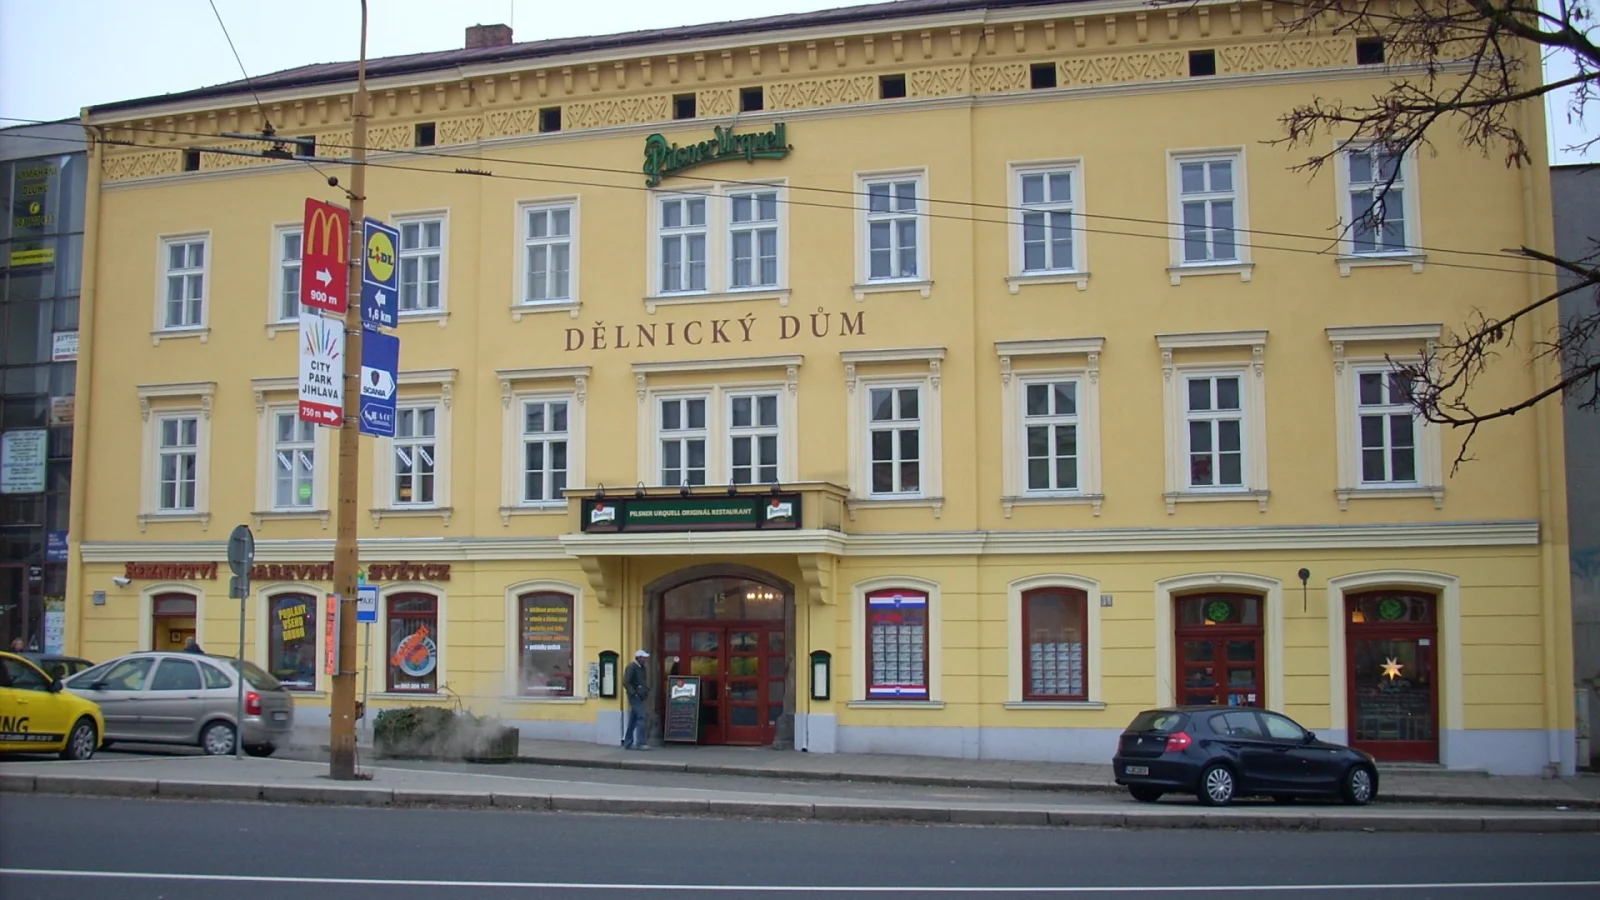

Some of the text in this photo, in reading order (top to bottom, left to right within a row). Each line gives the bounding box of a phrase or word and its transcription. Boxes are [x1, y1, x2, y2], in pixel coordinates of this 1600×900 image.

[643, 122, 786, 187] Pilsner Urquell
[310, 290, 338, 305] 900 m
[368, 307, 392, 324] 1,6 km
[564, 306, 866, 351] DĚLNICKÝ DŮM
[310, 360, 331, 373] CITY
[308, 372, 333, 386] PARK
[302, 383, 339, 400] JIHLAVA
[363, 385, 386, 398] SCANIA
[302, 406, 322, 418] 750 m
[653, 509, 681, 518] URQUELL
[711, 508, 752, 516] RESTAURANT
